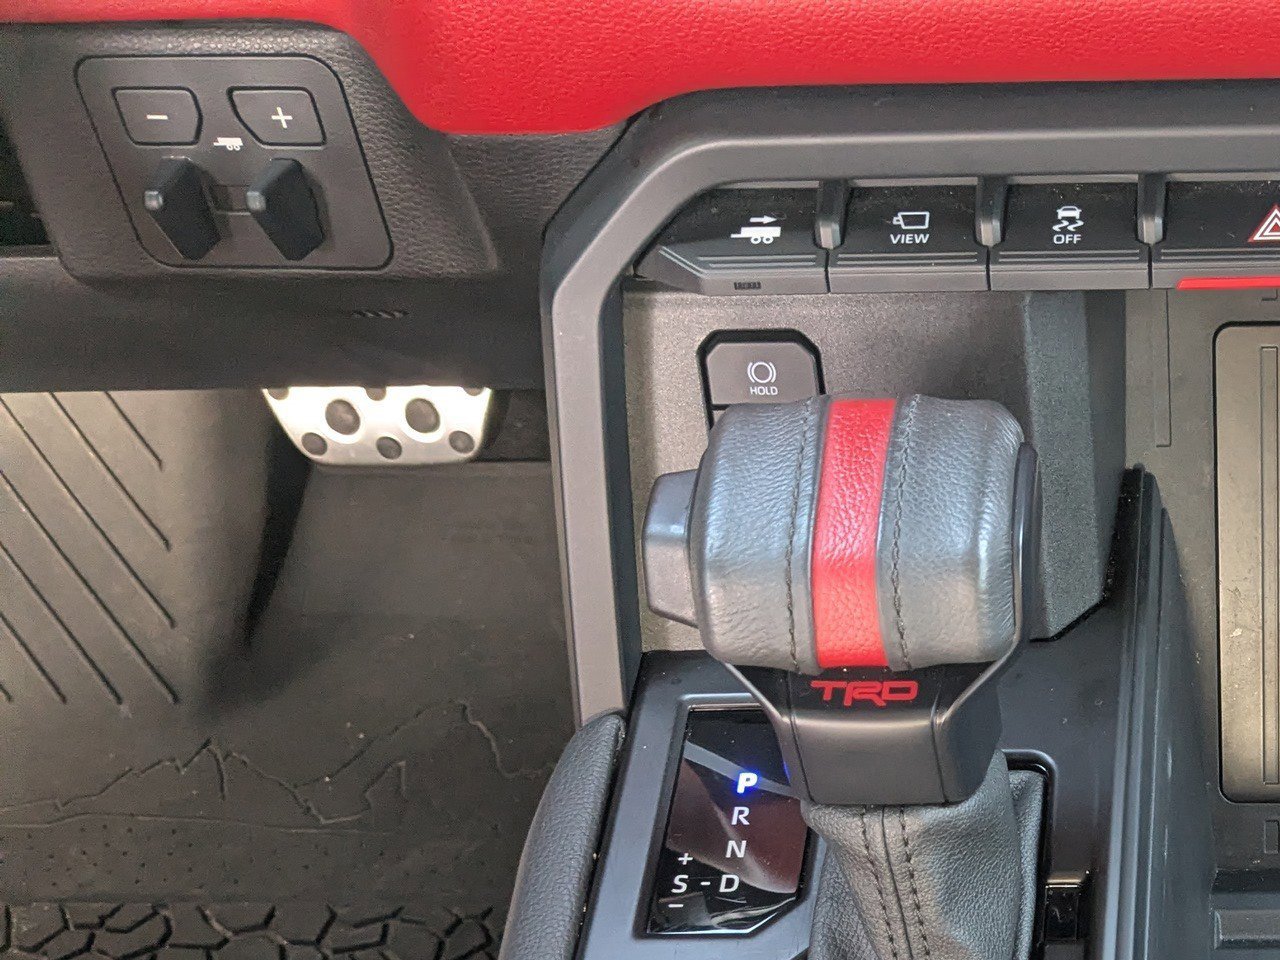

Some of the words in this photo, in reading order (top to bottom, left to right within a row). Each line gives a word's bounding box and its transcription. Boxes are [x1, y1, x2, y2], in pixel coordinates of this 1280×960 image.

[889, 233, 929, 245] VIEW
[1053, 233, 1082, 245] OFF
[750, 385, 779, 396] HOLD
[809, 680, 919, 707] TRD
[736, 772, 758, 794] P
[731, 806, 750, 826] R
[725, 840, 747, 859] N
